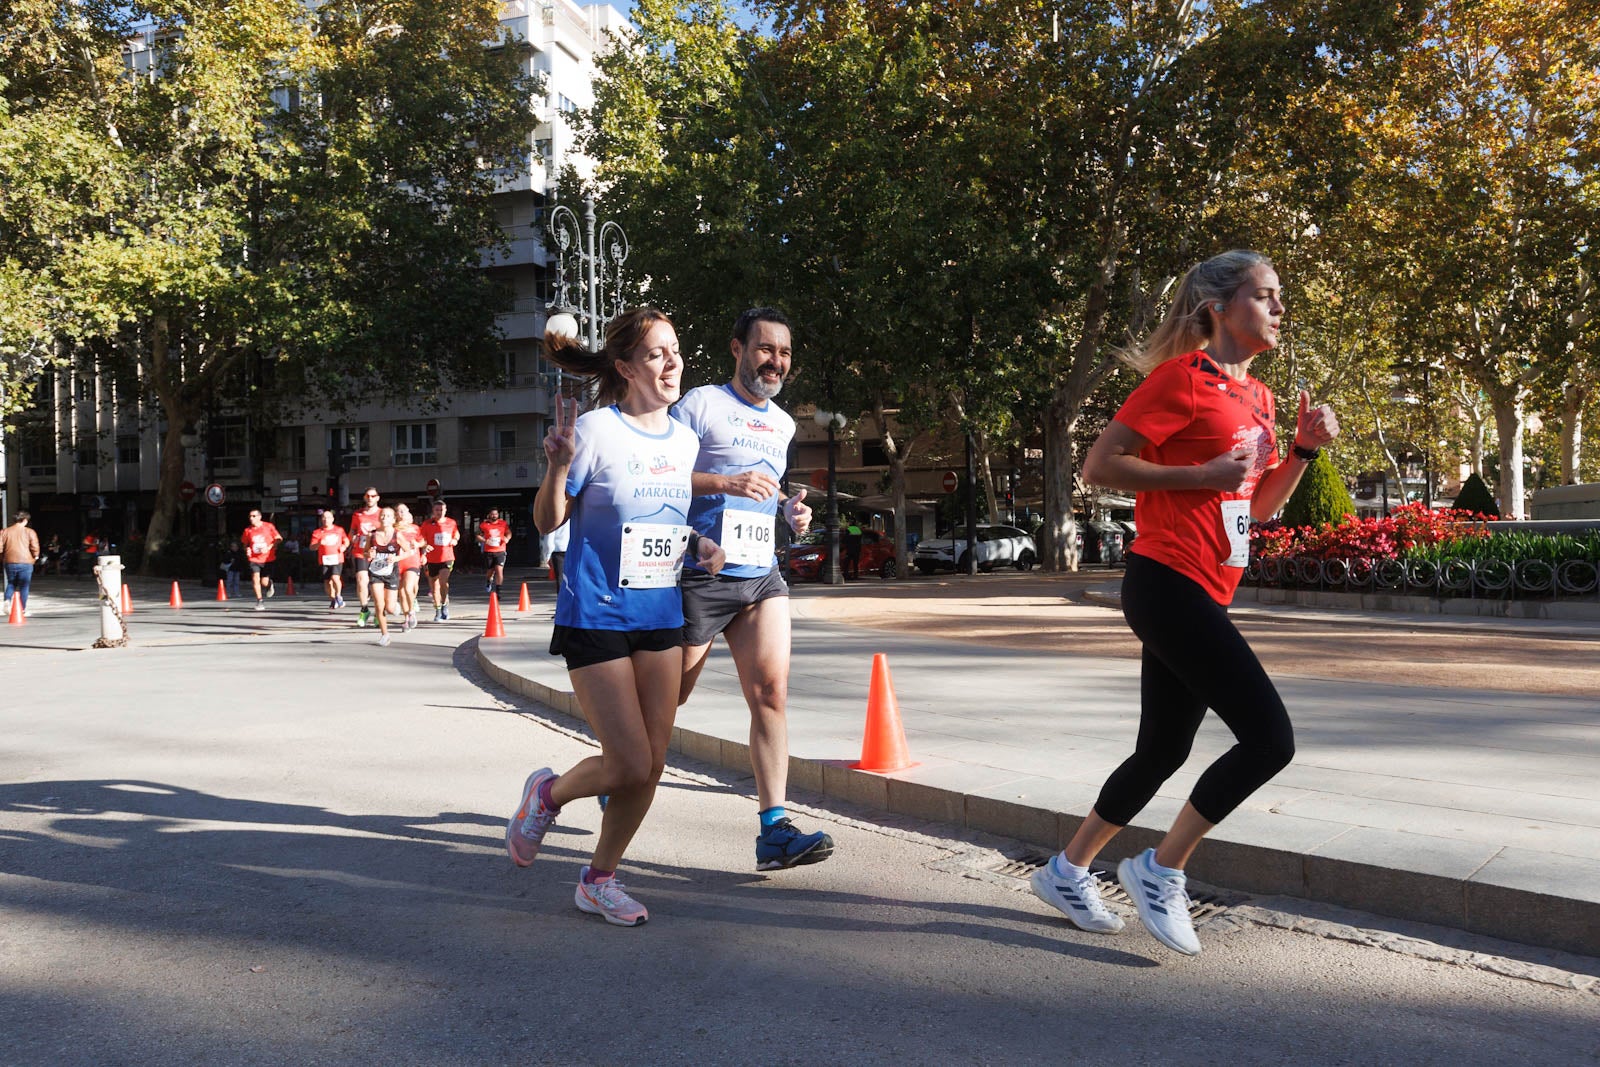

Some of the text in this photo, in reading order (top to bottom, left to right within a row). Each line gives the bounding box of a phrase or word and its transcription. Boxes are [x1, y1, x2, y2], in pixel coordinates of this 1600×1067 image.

[732, 436, 785, 459] MARACEN
[633, 487, 690, 499] MARACEN
[734, 523, 769, 543] 1108
[642, 538, 672, 557] 556
